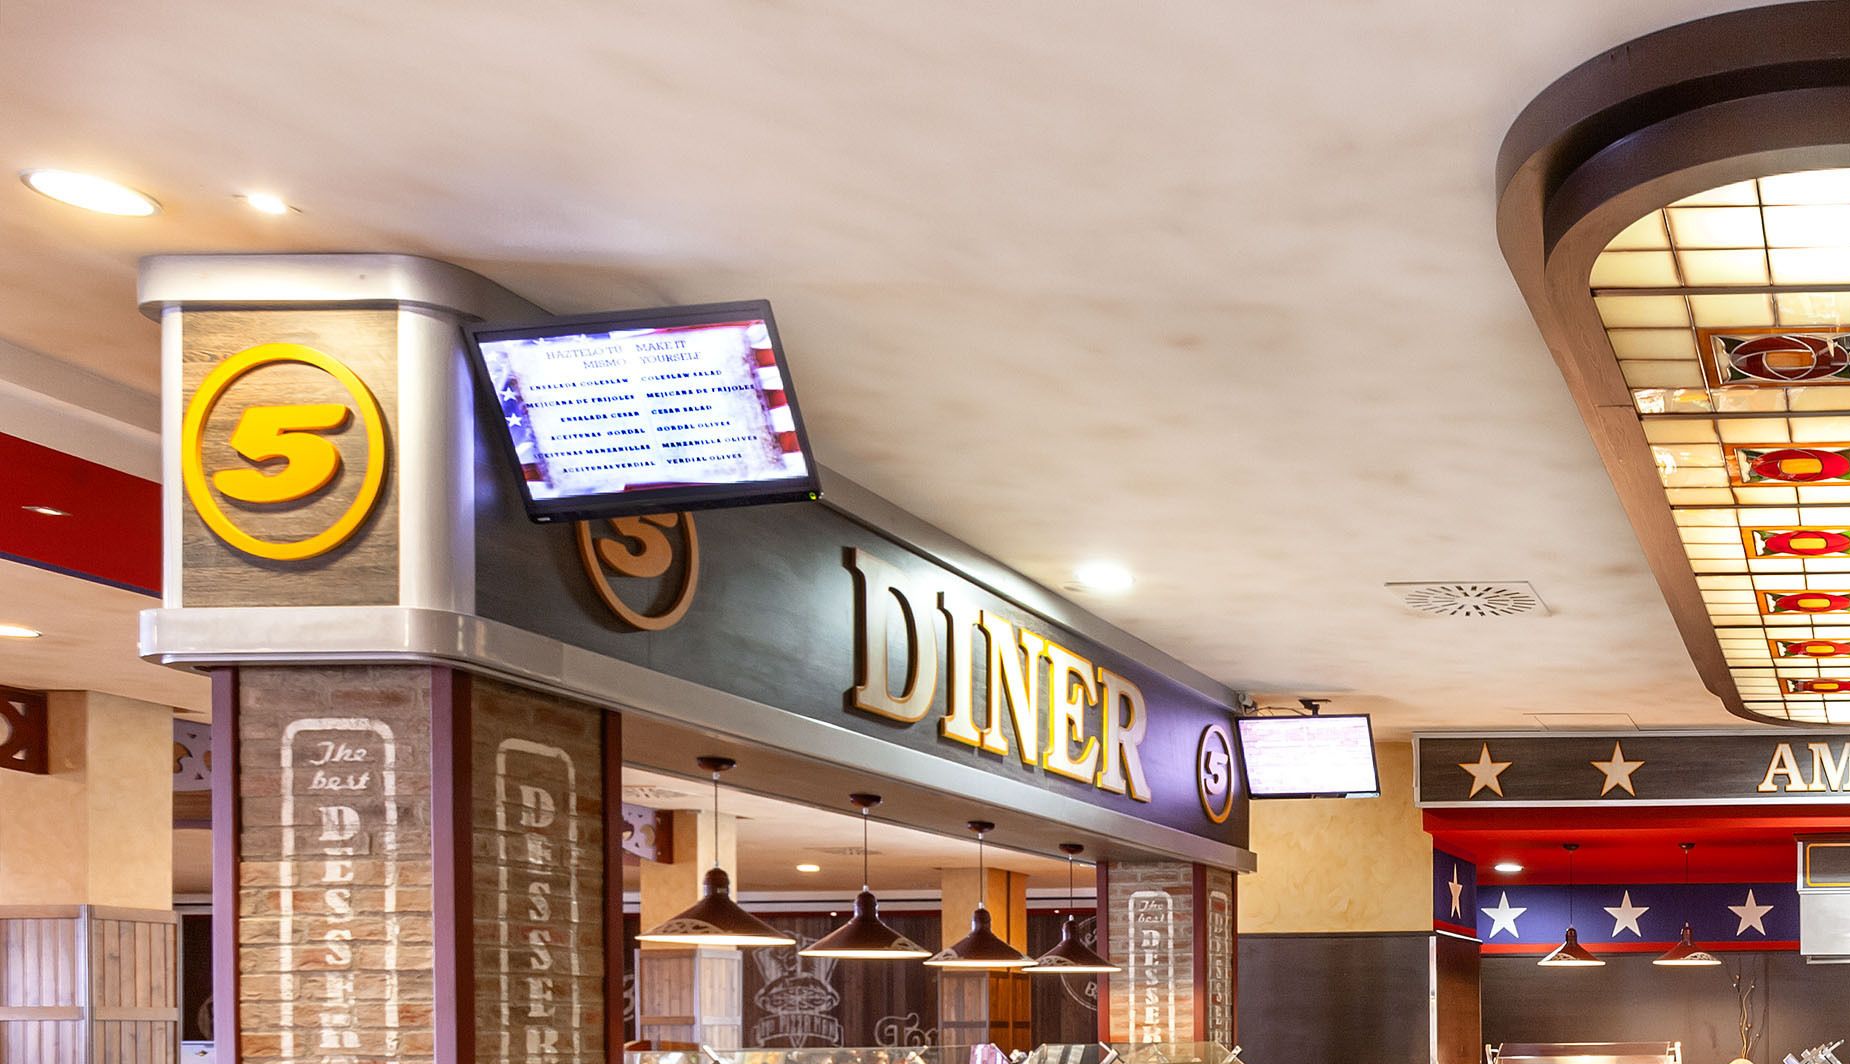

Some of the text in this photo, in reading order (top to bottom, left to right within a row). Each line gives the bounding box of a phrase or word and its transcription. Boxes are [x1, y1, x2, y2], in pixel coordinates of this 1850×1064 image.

[635, 339, 687, 352] MAKE IT
[583, 357, 627, 370] MISMO
[641, 372, 690, 381] COLESLAW
[651, 404, 713, 415] CESAR SALAD
[212, 402, 351, 504] 5
[848, 545, 1152, 804] DINER
[308, 741, 368, 767] The
[1203, 749, 1229, 796] 5
[308, 768, 370, 792] best
[1138, 900, 1165, 912] The
[1136, 912, 1166, 924] best
